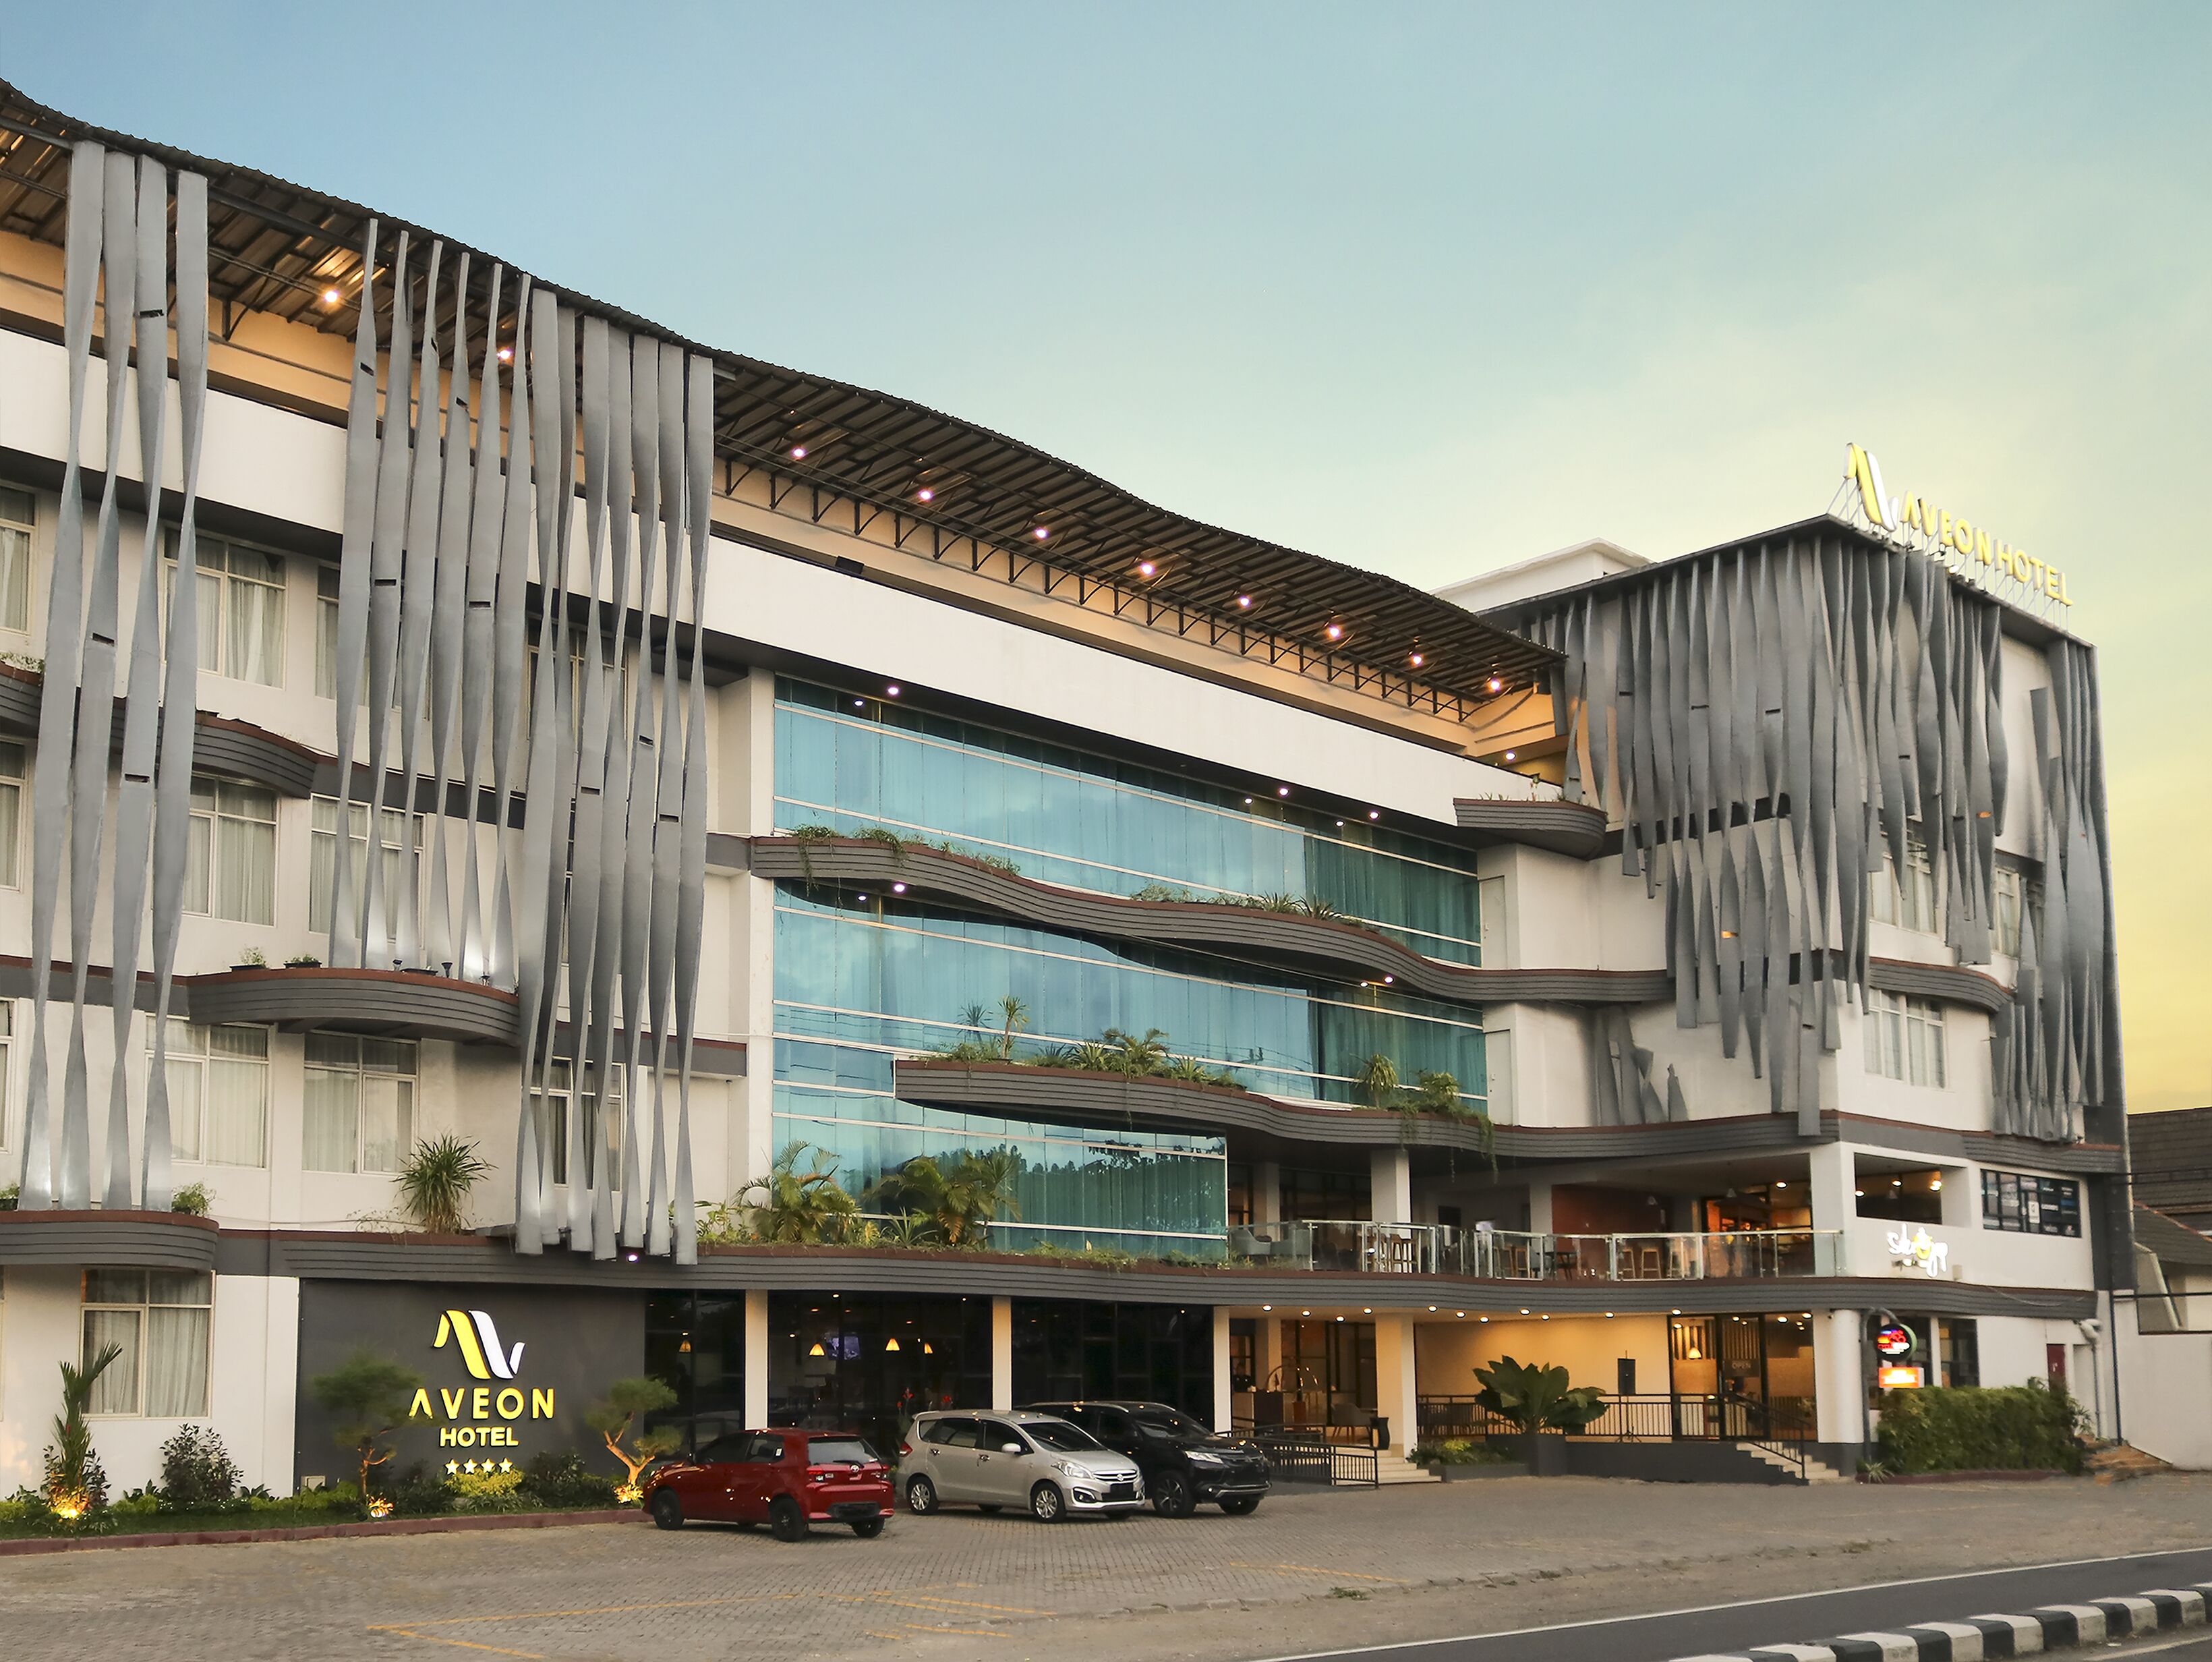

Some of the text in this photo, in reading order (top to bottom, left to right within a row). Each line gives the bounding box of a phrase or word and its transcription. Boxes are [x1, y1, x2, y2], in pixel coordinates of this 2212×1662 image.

[1900, 490, 2073, 606] AVEON HOTEL
[409, 1387, 555, 1420] AVEON
[440, 1427, 519, 1448] HOTEL
